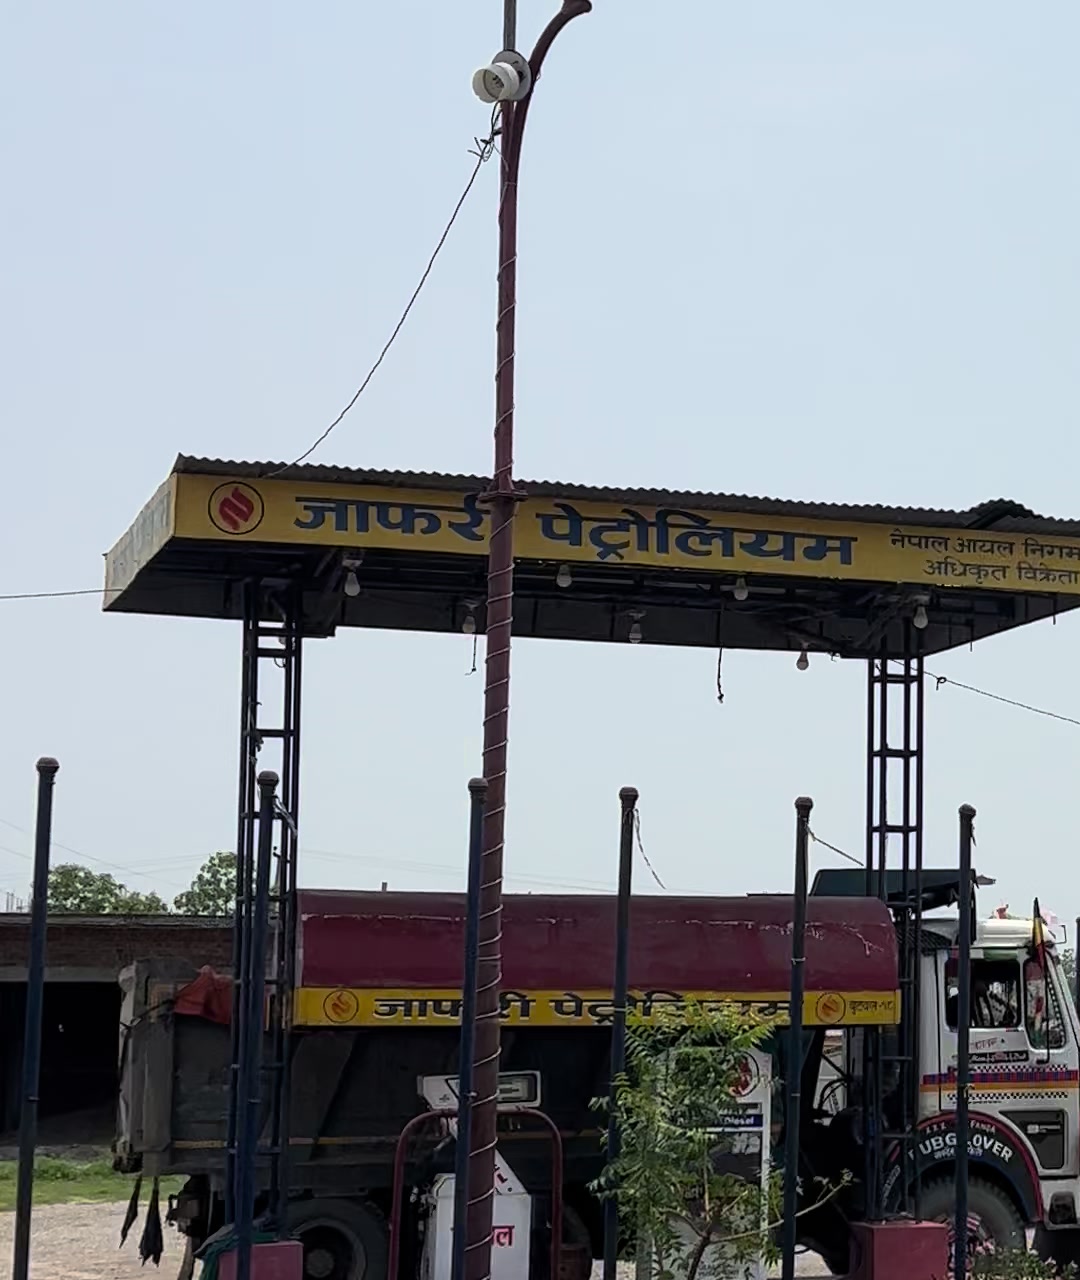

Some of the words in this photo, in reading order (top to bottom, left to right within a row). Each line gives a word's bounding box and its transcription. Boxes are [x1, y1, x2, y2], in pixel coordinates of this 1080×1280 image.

[294, 493, 493, 542] जाफर
[535, 502, 859, 566] पेट्रोलियम
[889, 528, 950, 553] नेपाल
[954, 536, 1016, 557] आयल
[923, 556, 1011, 586] अधिकृत
[1016, 560, 1080, 586] विक्रेता
